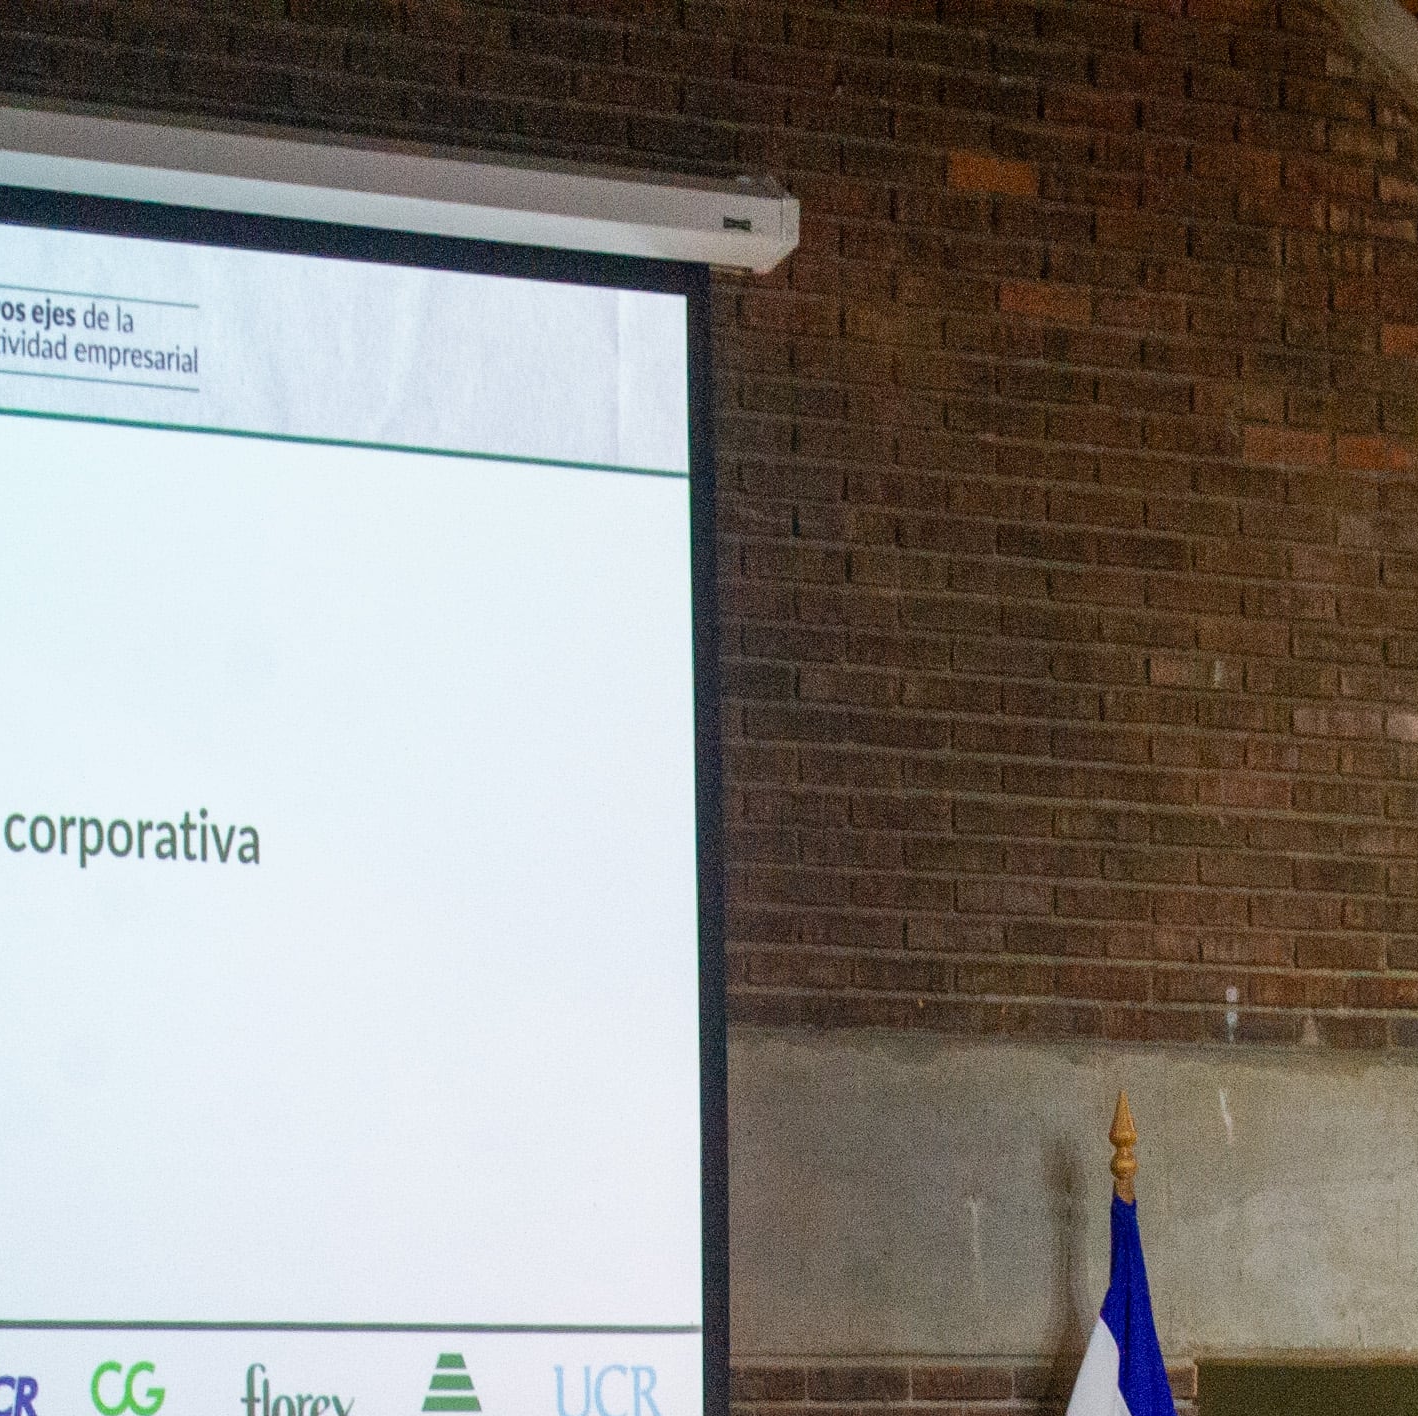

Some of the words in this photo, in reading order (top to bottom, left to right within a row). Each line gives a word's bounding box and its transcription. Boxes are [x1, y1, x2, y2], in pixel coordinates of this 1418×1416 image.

[31, 300, 77, 332] ejes
[82, 303, 110, 332] de
[116, 304, 135, 335] la
[73, 342, 199, 375] empresarial
[3, 808, 261, 869] corporativa
